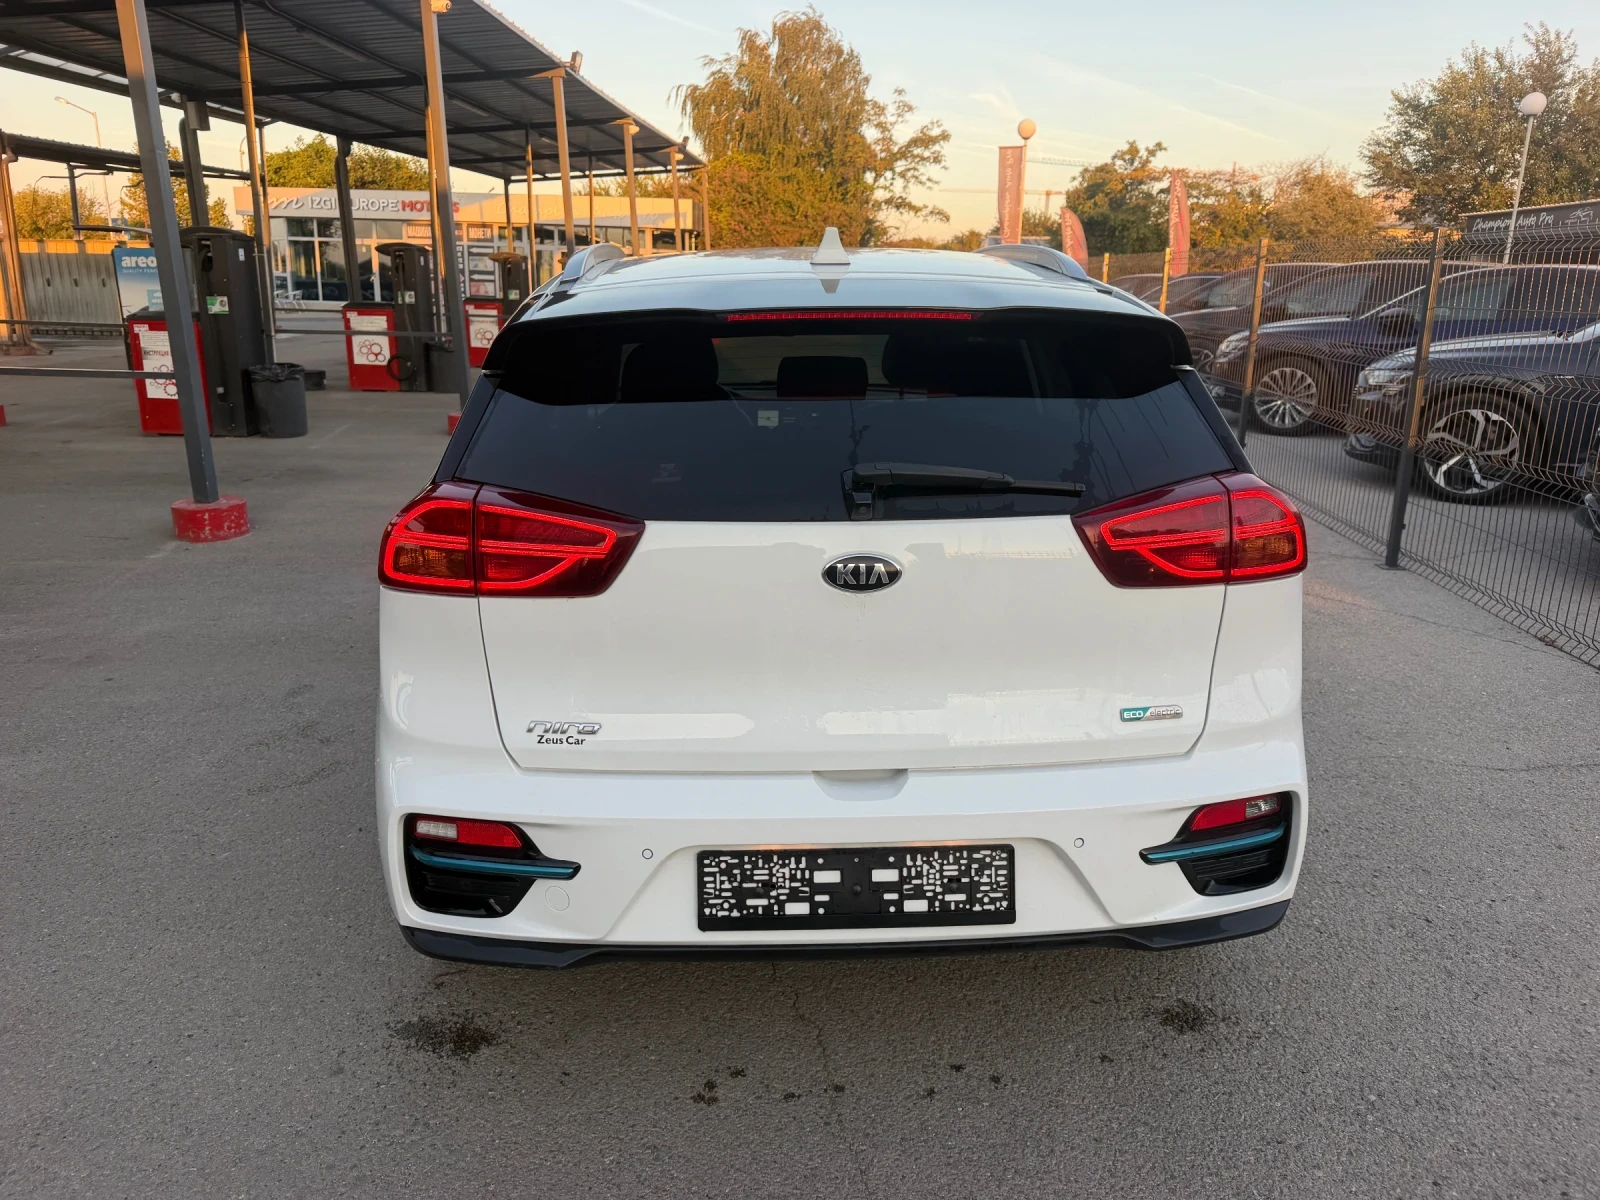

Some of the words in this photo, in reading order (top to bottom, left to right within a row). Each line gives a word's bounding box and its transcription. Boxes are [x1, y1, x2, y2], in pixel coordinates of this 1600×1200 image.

[308, 196, 336, 209] IZGI
[351, 198, 399, 211] UROPE
[401, 200, 460, 213] MOTS
[1473, 217, 1512, 231] Champion
[1516, 213, 1537, 226] Auto
[1539, 212, 1554, 225] Pro
[121, 256, 157, 268] areo
[836, 563, 890, 585] KIA
[1150, 708, 1181, 716] electric
[537, 735, 564, 745] Zeus
[565, 735, 586, 746] Car
